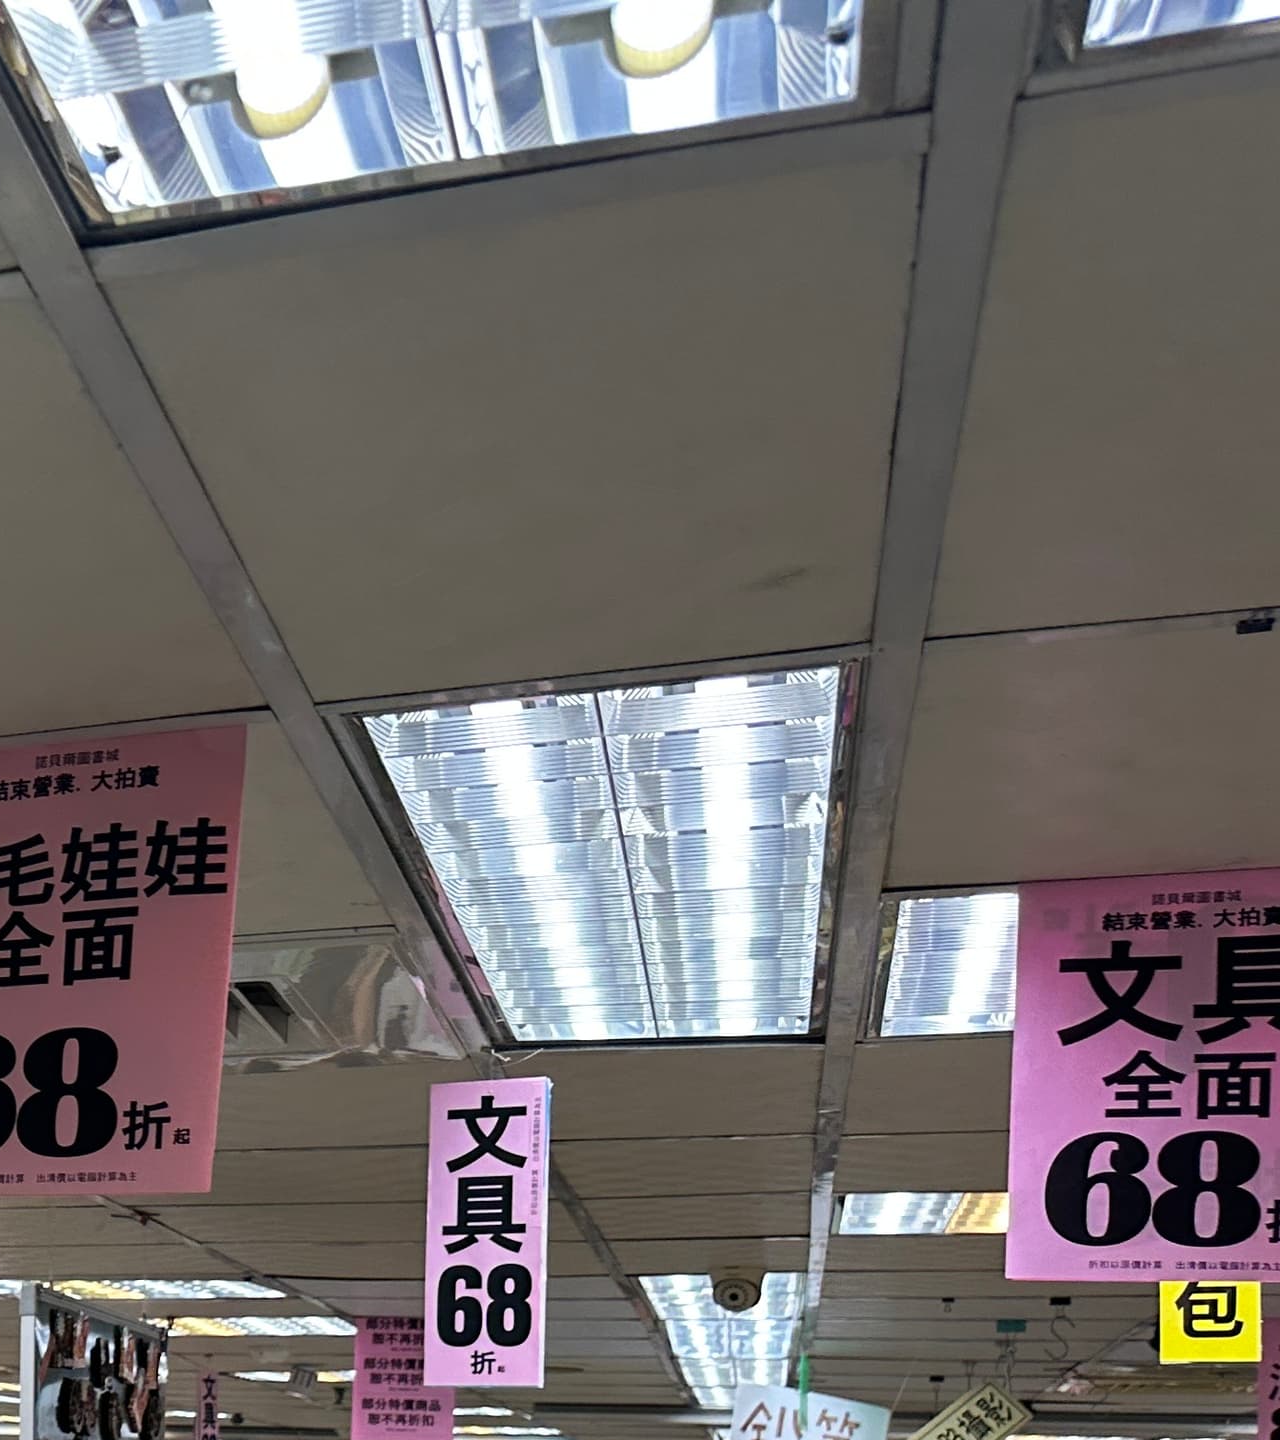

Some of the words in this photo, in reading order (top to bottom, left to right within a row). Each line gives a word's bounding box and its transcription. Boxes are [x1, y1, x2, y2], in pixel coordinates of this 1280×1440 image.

[91, 765, 160, 793] 大拍賣
[1057, 935, 1280, 1047] 文具
[1102, 1050, 1277, 1119] 全面
[442, 1095, 527, 1254] 文具
[366, 1319, 424, 1330] 部分特價
[437, 1264, 532, 1347] 68
[1174, 1279, 1244, 1338] 包
[372, 1333, 424, 1344] 恕不再折
[370, 1373, 424, 1385] 恕不再折
